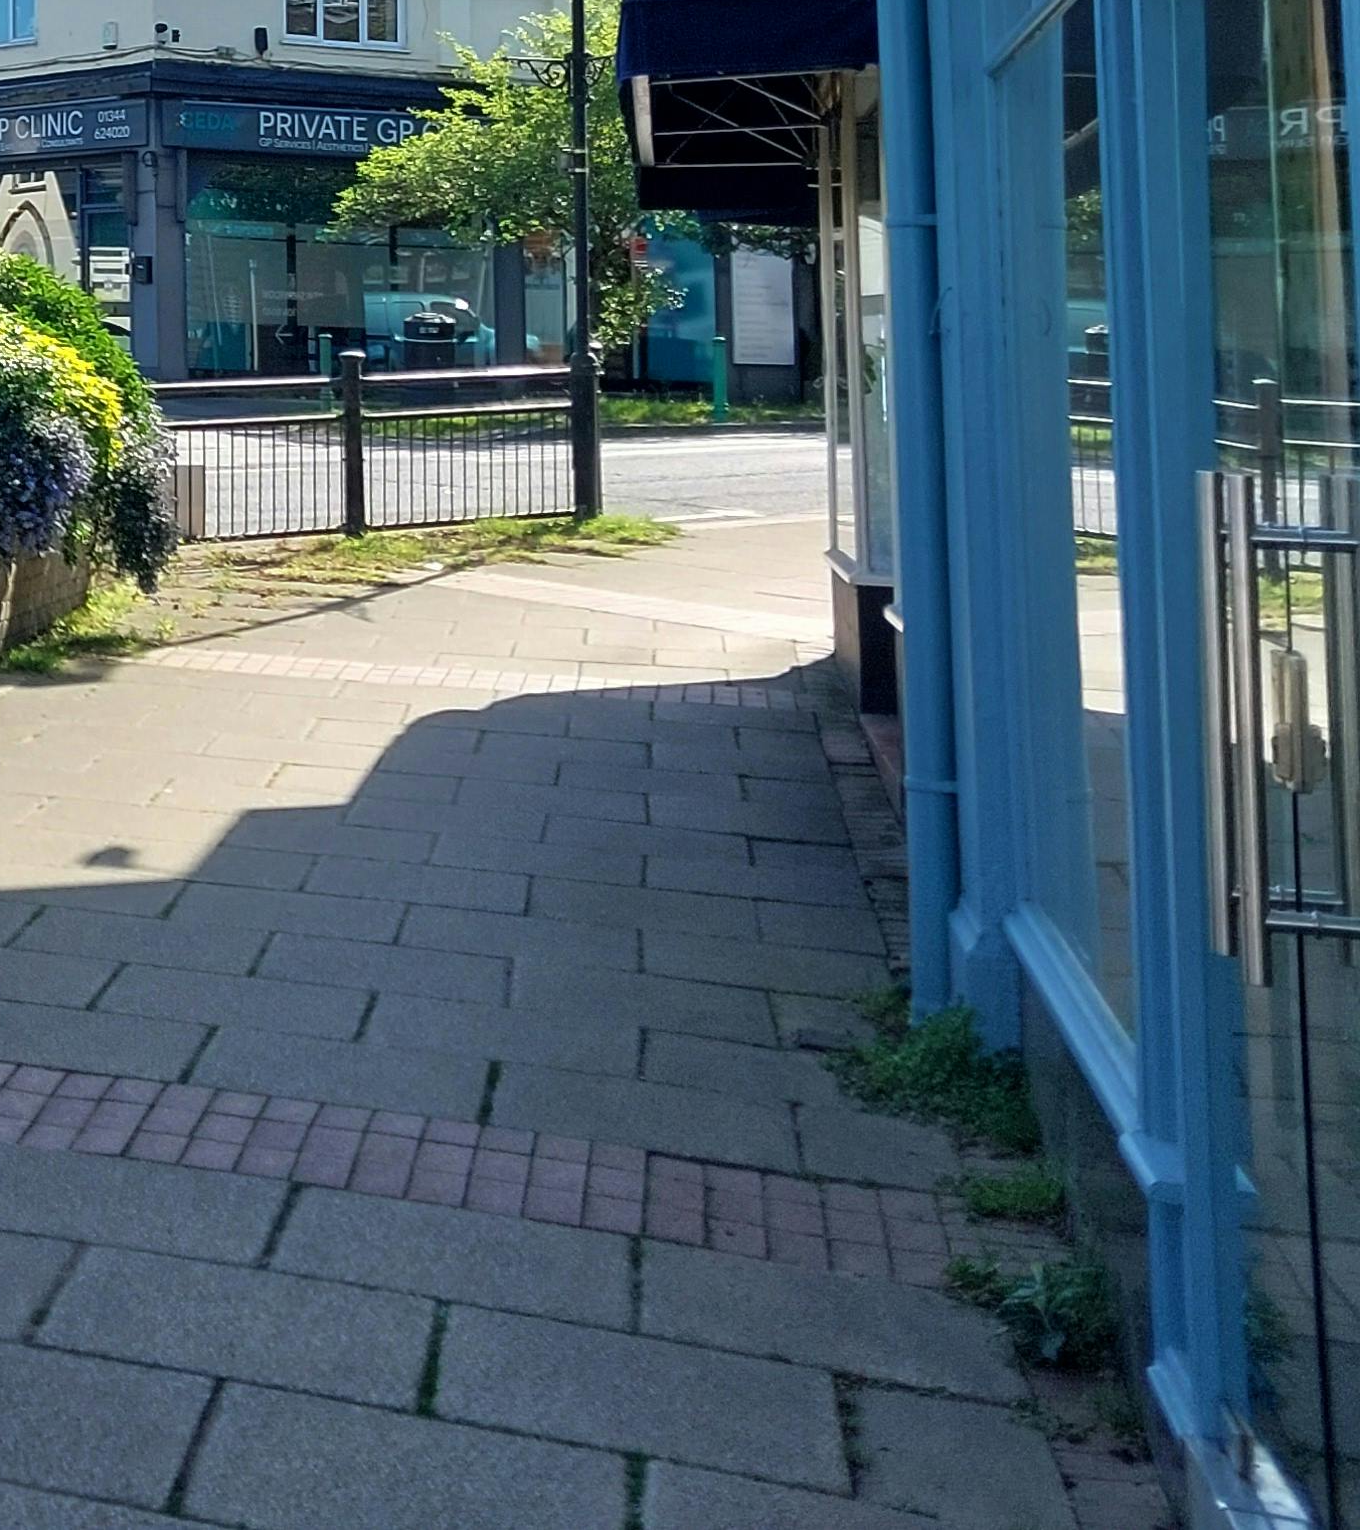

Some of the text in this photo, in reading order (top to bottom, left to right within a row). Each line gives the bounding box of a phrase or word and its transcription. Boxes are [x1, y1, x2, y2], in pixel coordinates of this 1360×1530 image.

[15, 110, 83, 139] CLINIC
[97, 109, 126, 123] 01344
[94, 125, 130, 140] 624020
[259, 111, 368, 143] PRIVATE
[377, 118, 414, 144] GP
